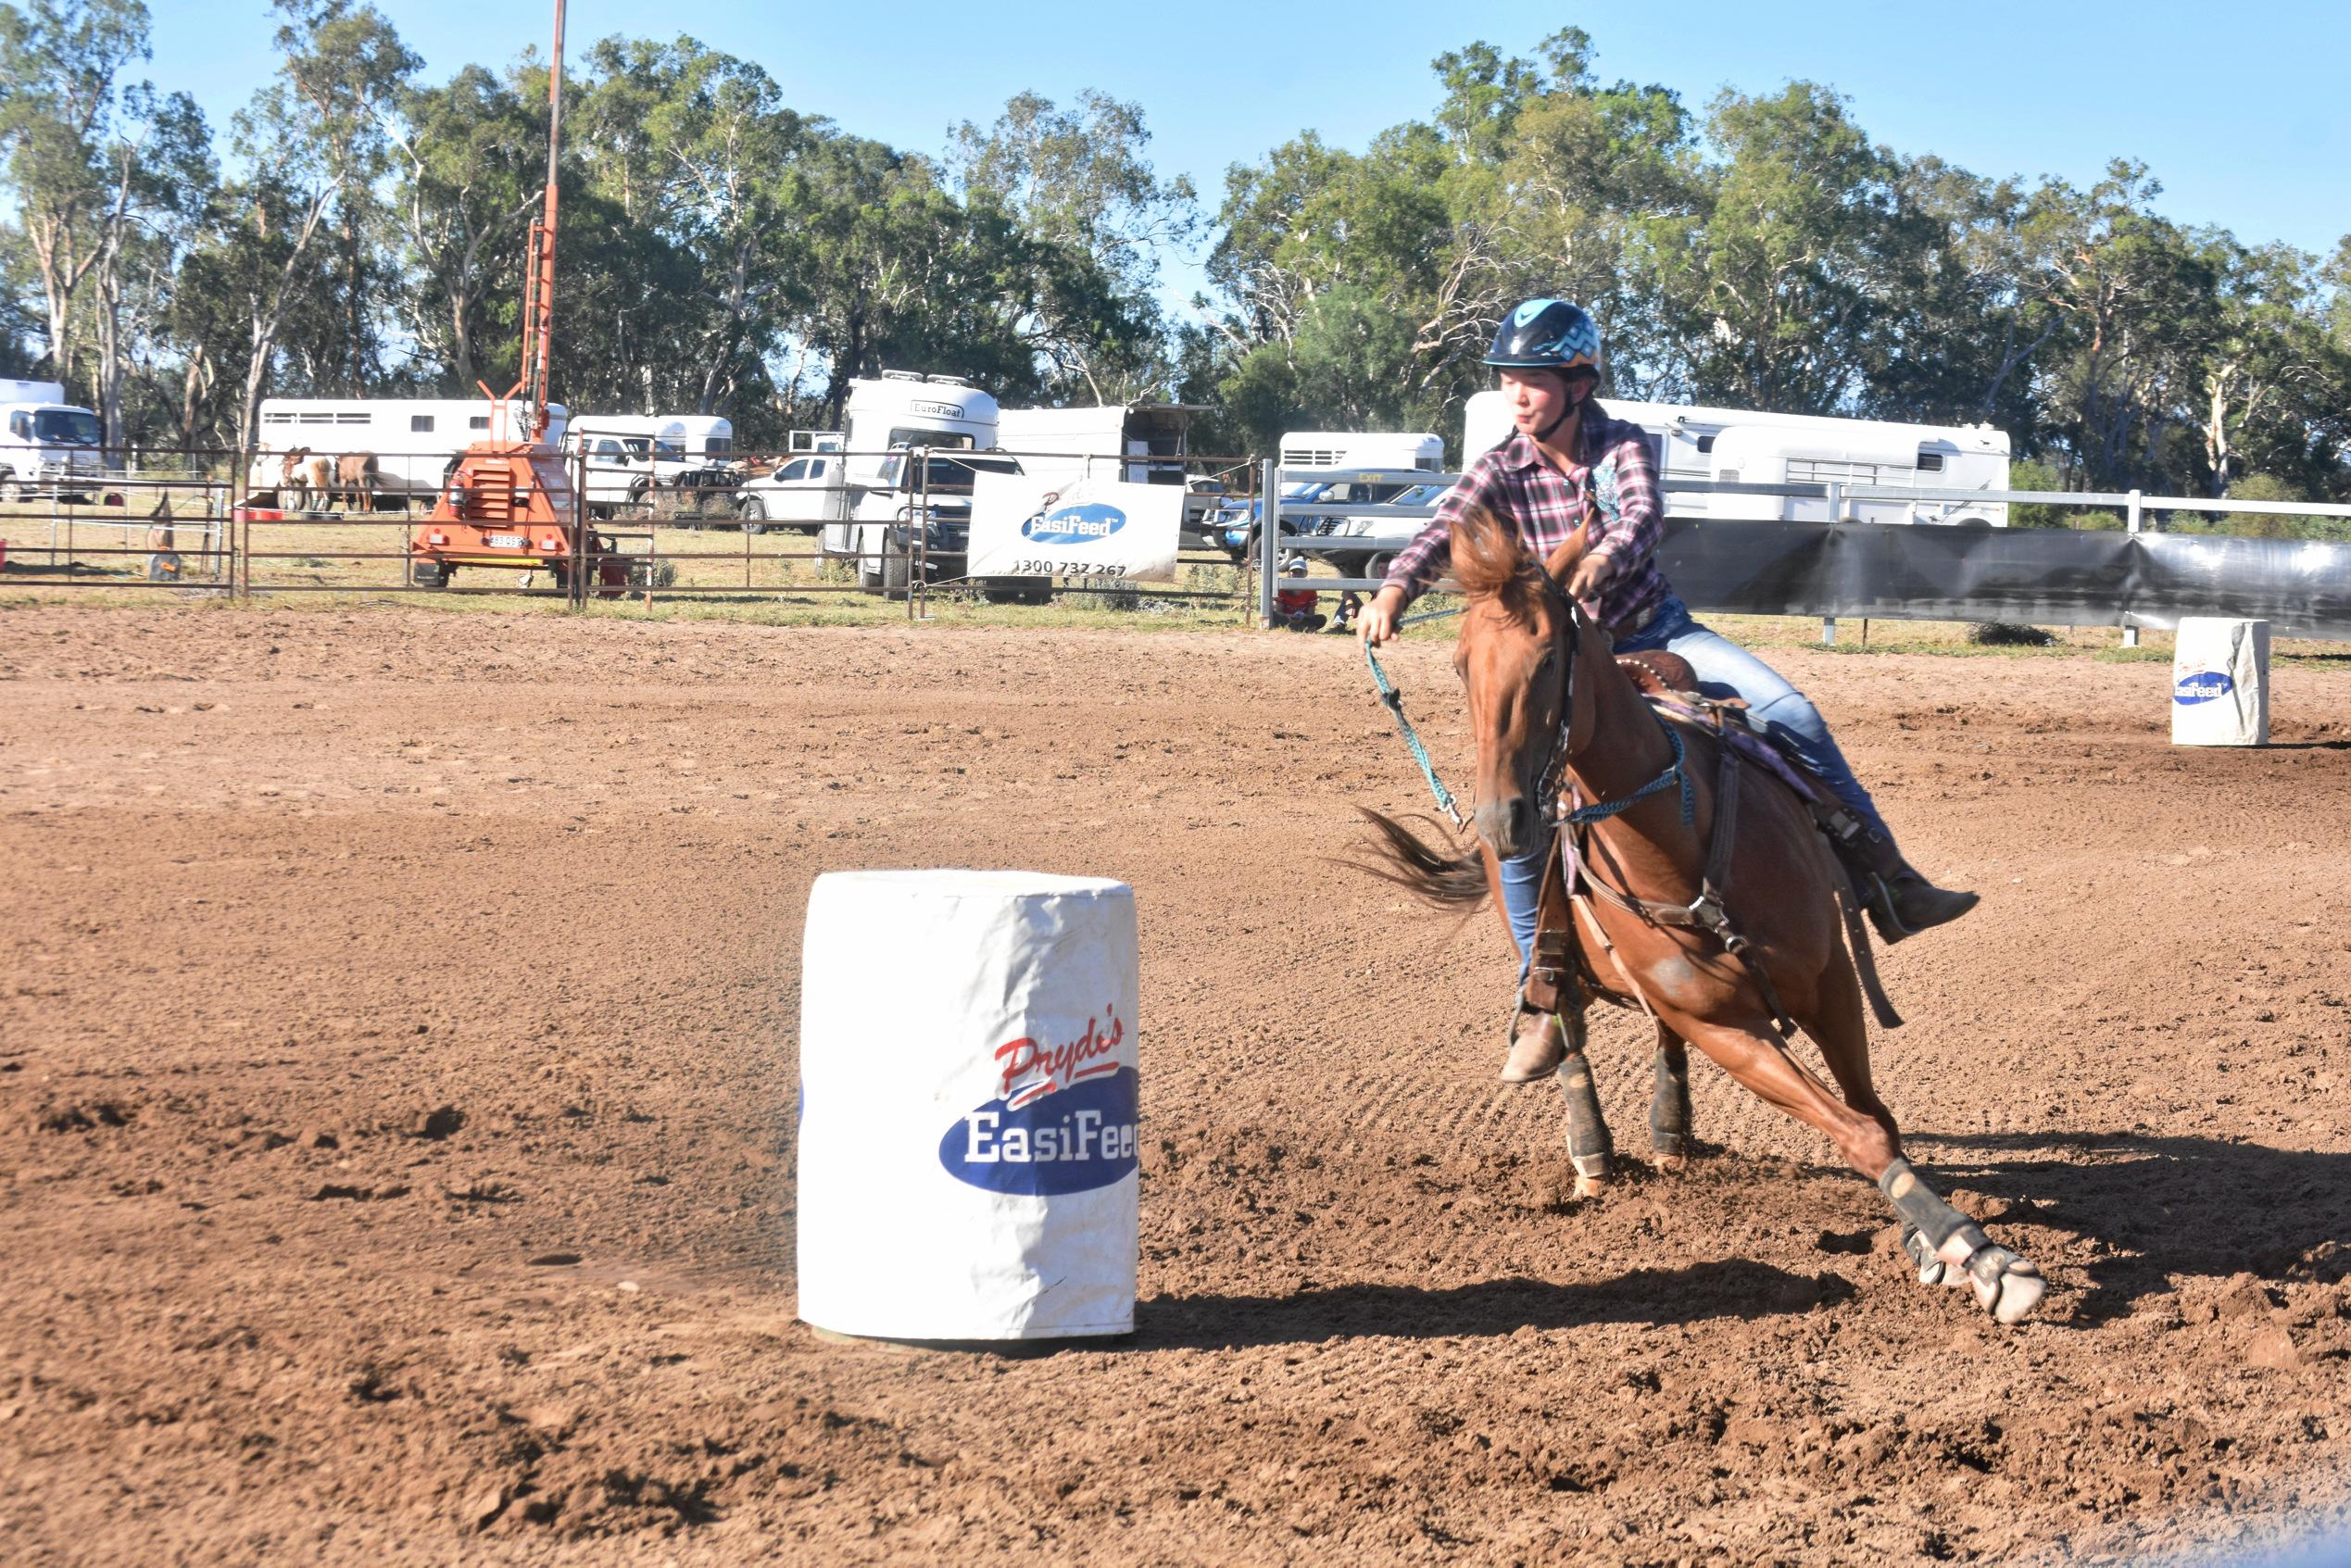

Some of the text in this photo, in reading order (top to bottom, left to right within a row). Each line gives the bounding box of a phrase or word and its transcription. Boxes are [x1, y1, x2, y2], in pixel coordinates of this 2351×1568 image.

[913, 403, 961, 418] EuroFloat
[1358, 473, 1384, 483] EXIT
[1029, 515, 1112, 536] EasiFeed
[1012, 559, 1127, 576] 1300 732 267
